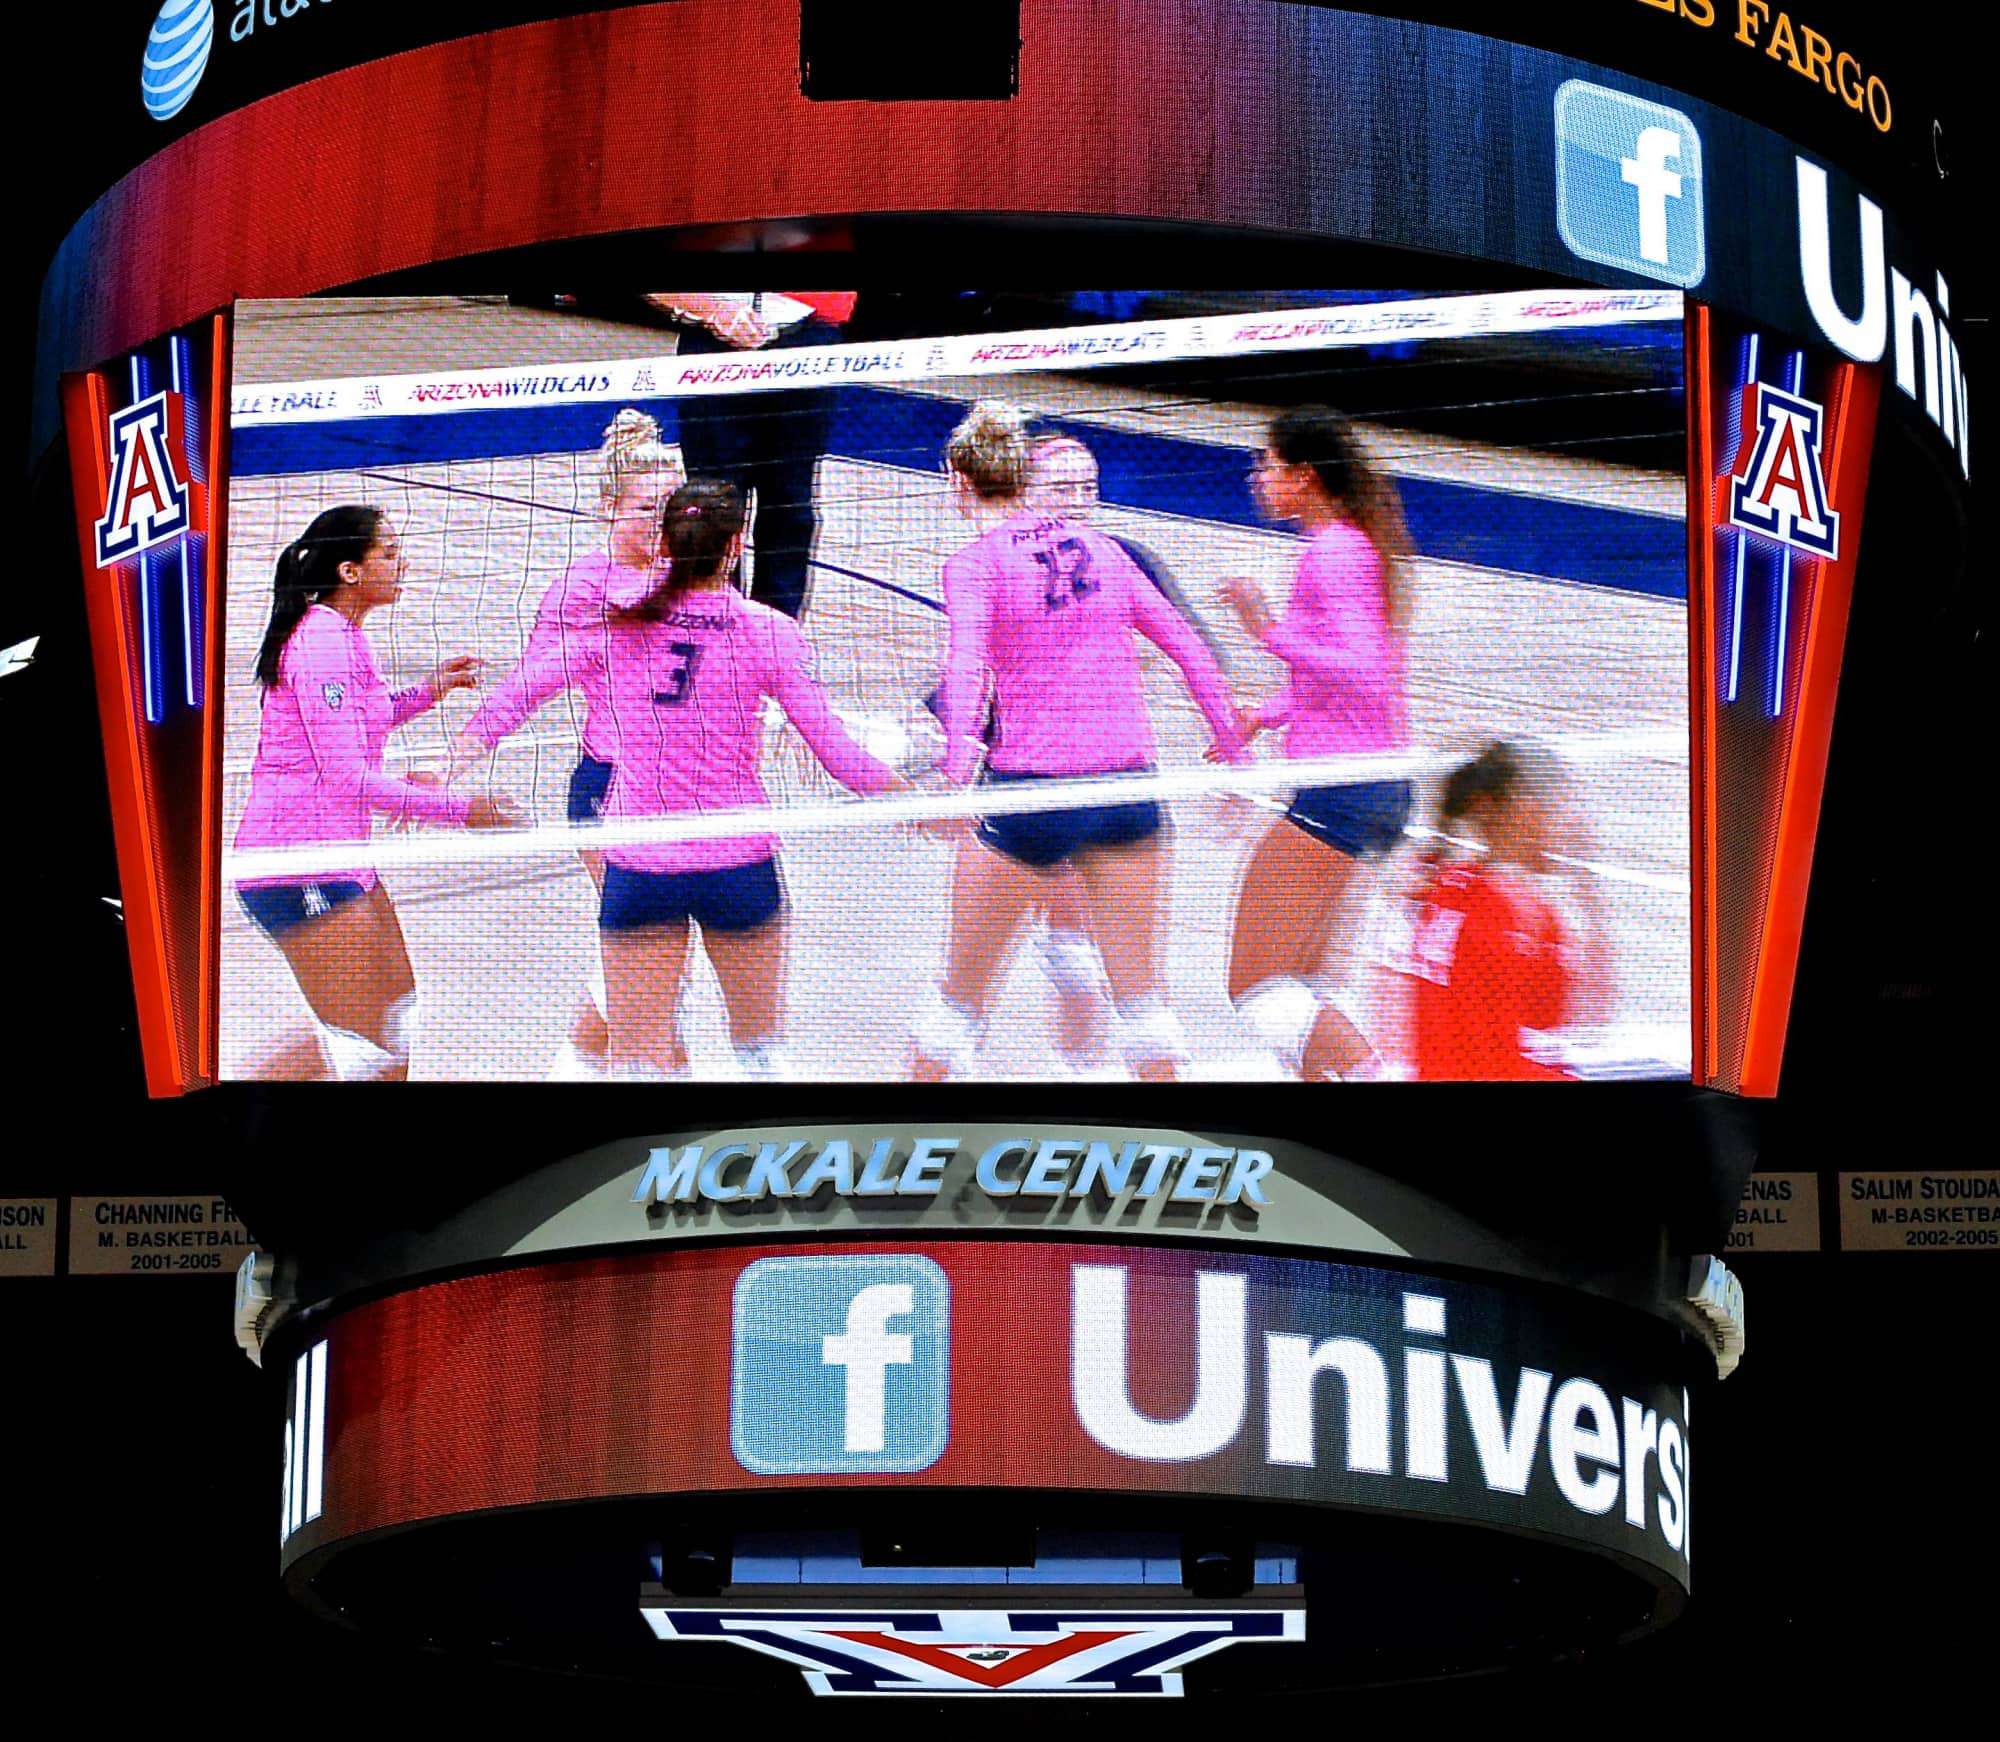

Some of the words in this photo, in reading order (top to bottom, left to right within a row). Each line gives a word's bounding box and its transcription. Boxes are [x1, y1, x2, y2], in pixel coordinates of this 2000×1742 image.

[1735, 0, 1892, 132] FARGO
[95, 390, 190, 569] A
[1730, 380, 1840, 561] A
[653, 642, 703, 705] 3
[631, 1138, 961, 1203] MCKALE
[976, 1138, 1275, 1207] CENTER
[1851, 1178, 1912, 1200] SALIM
[0, 1206, 45, 1226] SON
[95, 1202, 203, 1225] CHANNING
[99, 1232, 119, 1248] M.
[1906, 1230, 1998, 1246] 2002-2005
[131, 1253, 222, 1270] 2001-2005
